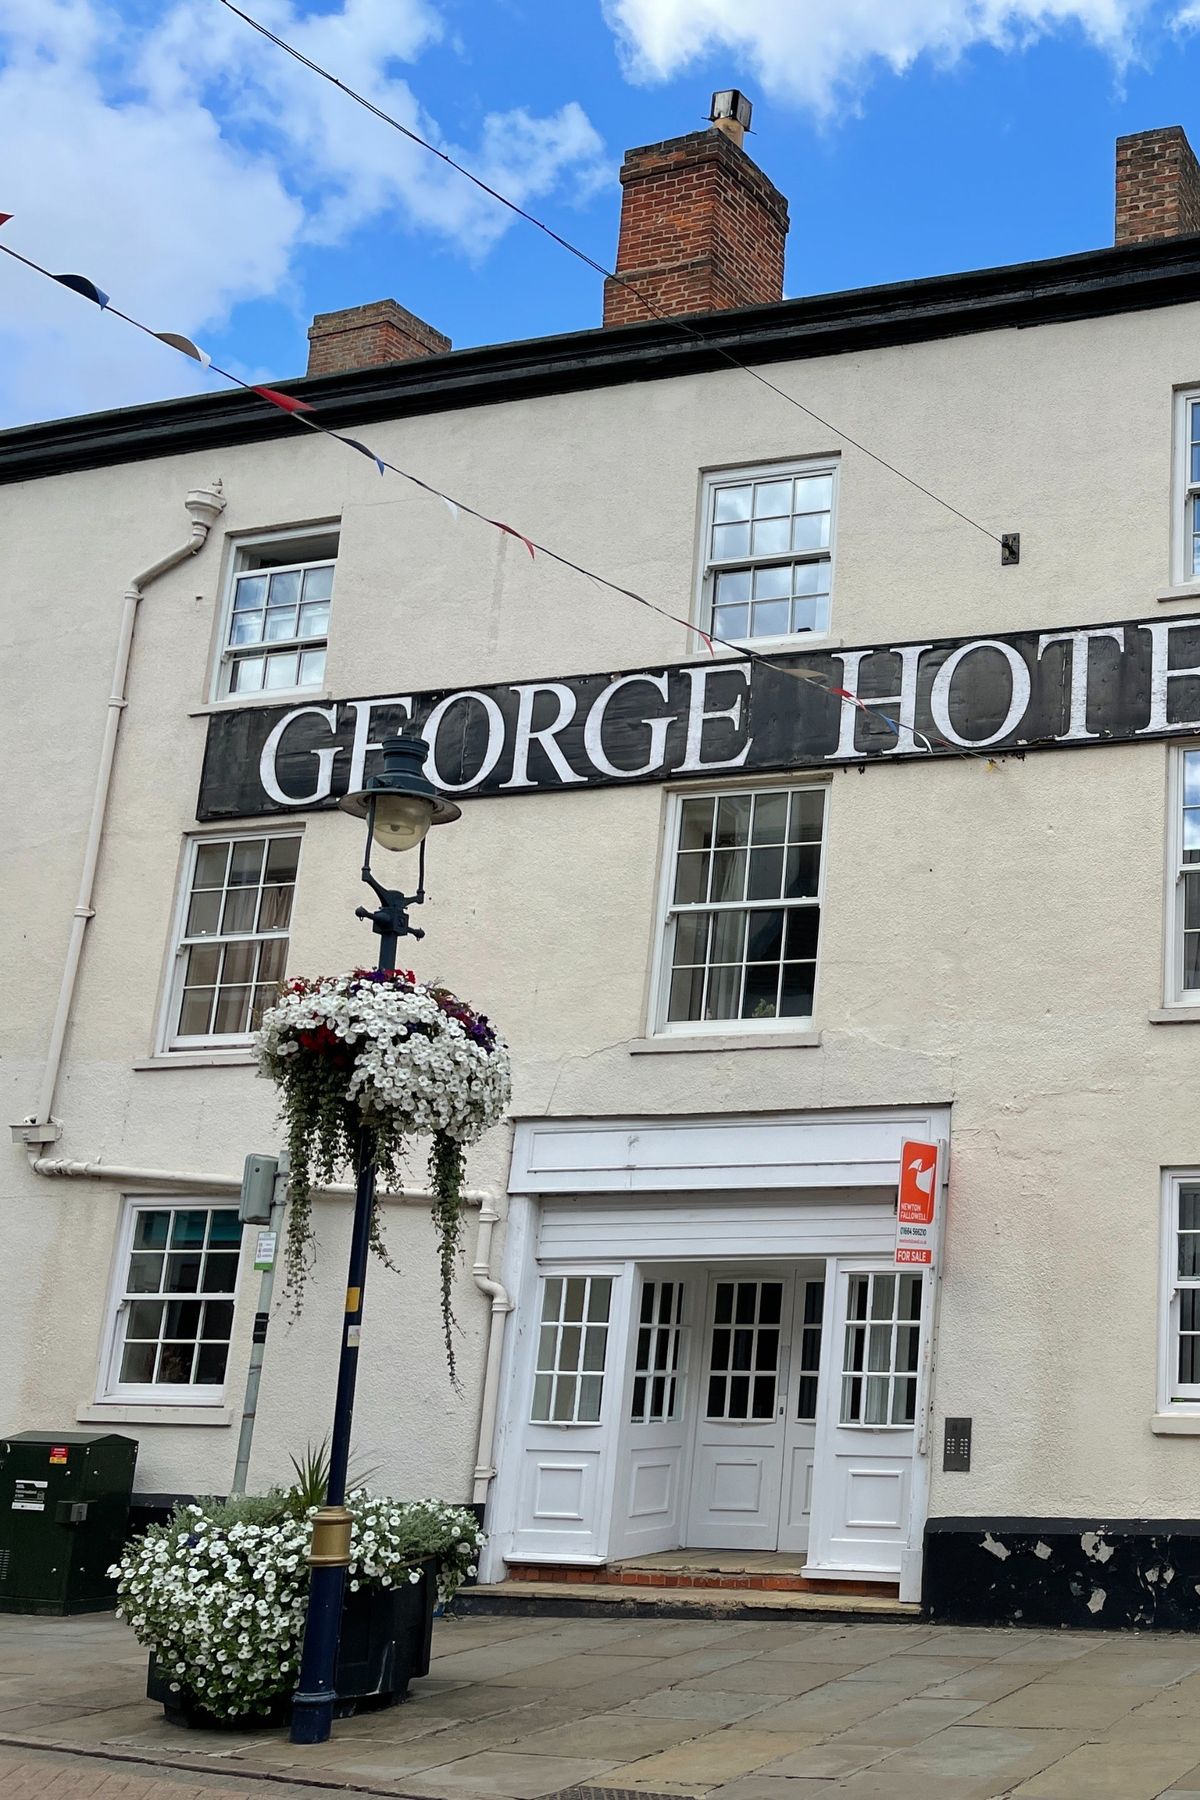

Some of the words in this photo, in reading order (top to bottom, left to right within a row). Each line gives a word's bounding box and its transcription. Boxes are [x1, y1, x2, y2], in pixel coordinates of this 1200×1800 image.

[901, 1203, 921, 1211] NEWTON
[900, 1211, 928, 1220] FALLOWELL
[897, 1250, 911, 1261] FOR
[911, 1251, 927, 1262] SALE
